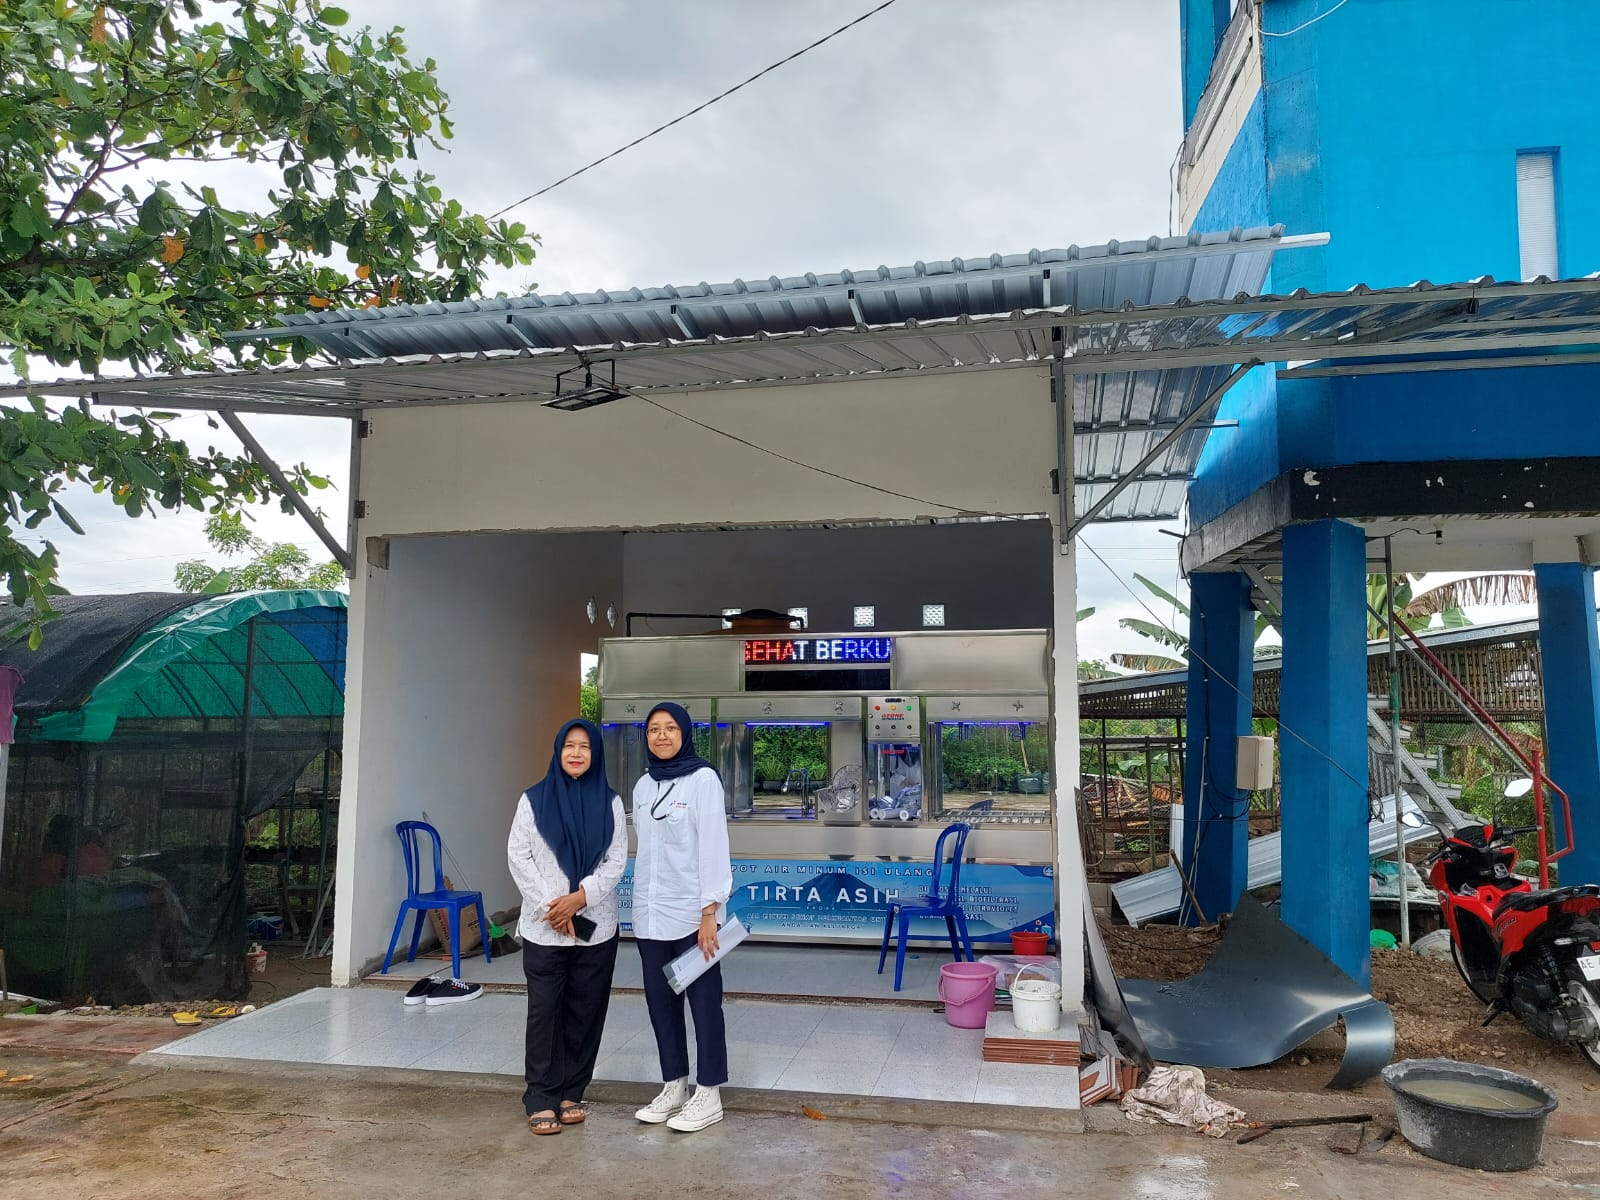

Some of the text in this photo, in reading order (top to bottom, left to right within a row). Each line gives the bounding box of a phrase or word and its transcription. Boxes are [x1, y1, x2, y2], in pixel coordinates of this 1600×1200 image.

[764, 865, 790, 873] AIR
[797, 866, 847, 874] MINUM
[856, 867, 876, 875] ISI
[884, 868, 933, 876] ULANG
[747, 885, 822, 902] TIRTA
[836, 887, 900, 904] ASIH
